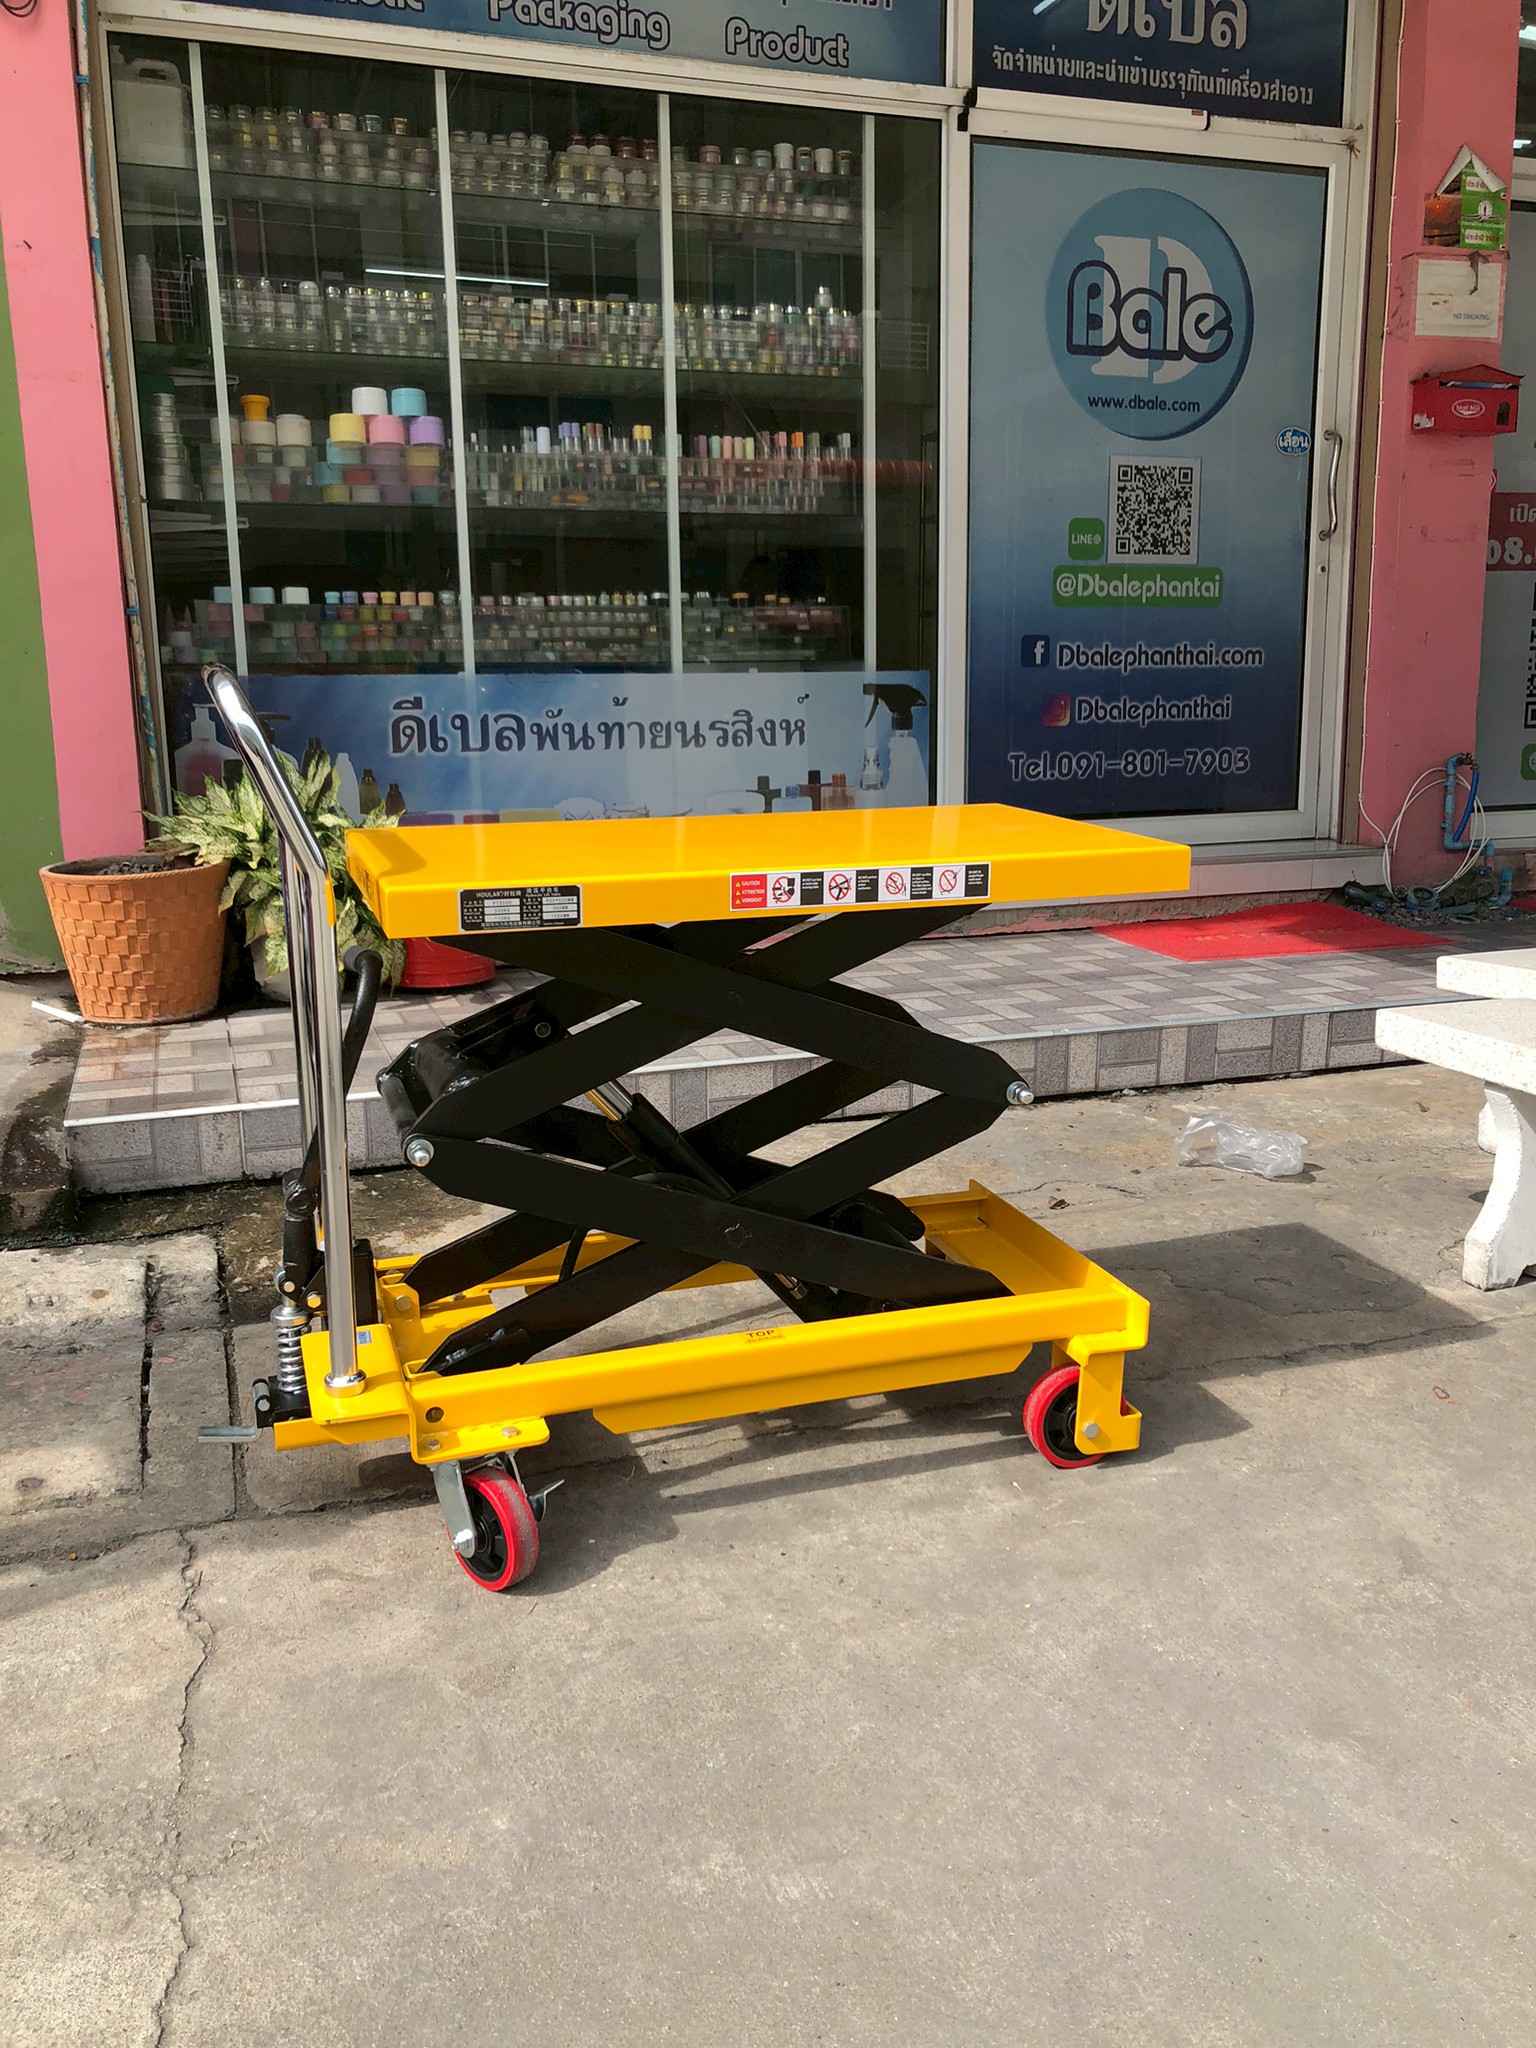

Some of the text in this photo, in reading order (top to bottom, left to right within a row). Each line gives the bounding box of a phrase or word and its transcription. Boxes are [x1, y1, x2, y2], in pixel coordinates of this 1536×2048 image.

[486, 0, 849, 68] Packaging Product
[1087, 394, 1201, 413] www.dbale.com
[1071, 533, 1102, 545] LINE@
[1056, 573, 1221, 604] @Dbalephantai
[1056, 641, 1264, 674] Dbalephanthai.com
[1076, 695, 1232, 727] Dbalephanthai
[746, 1329, 774, 1338] TOP
